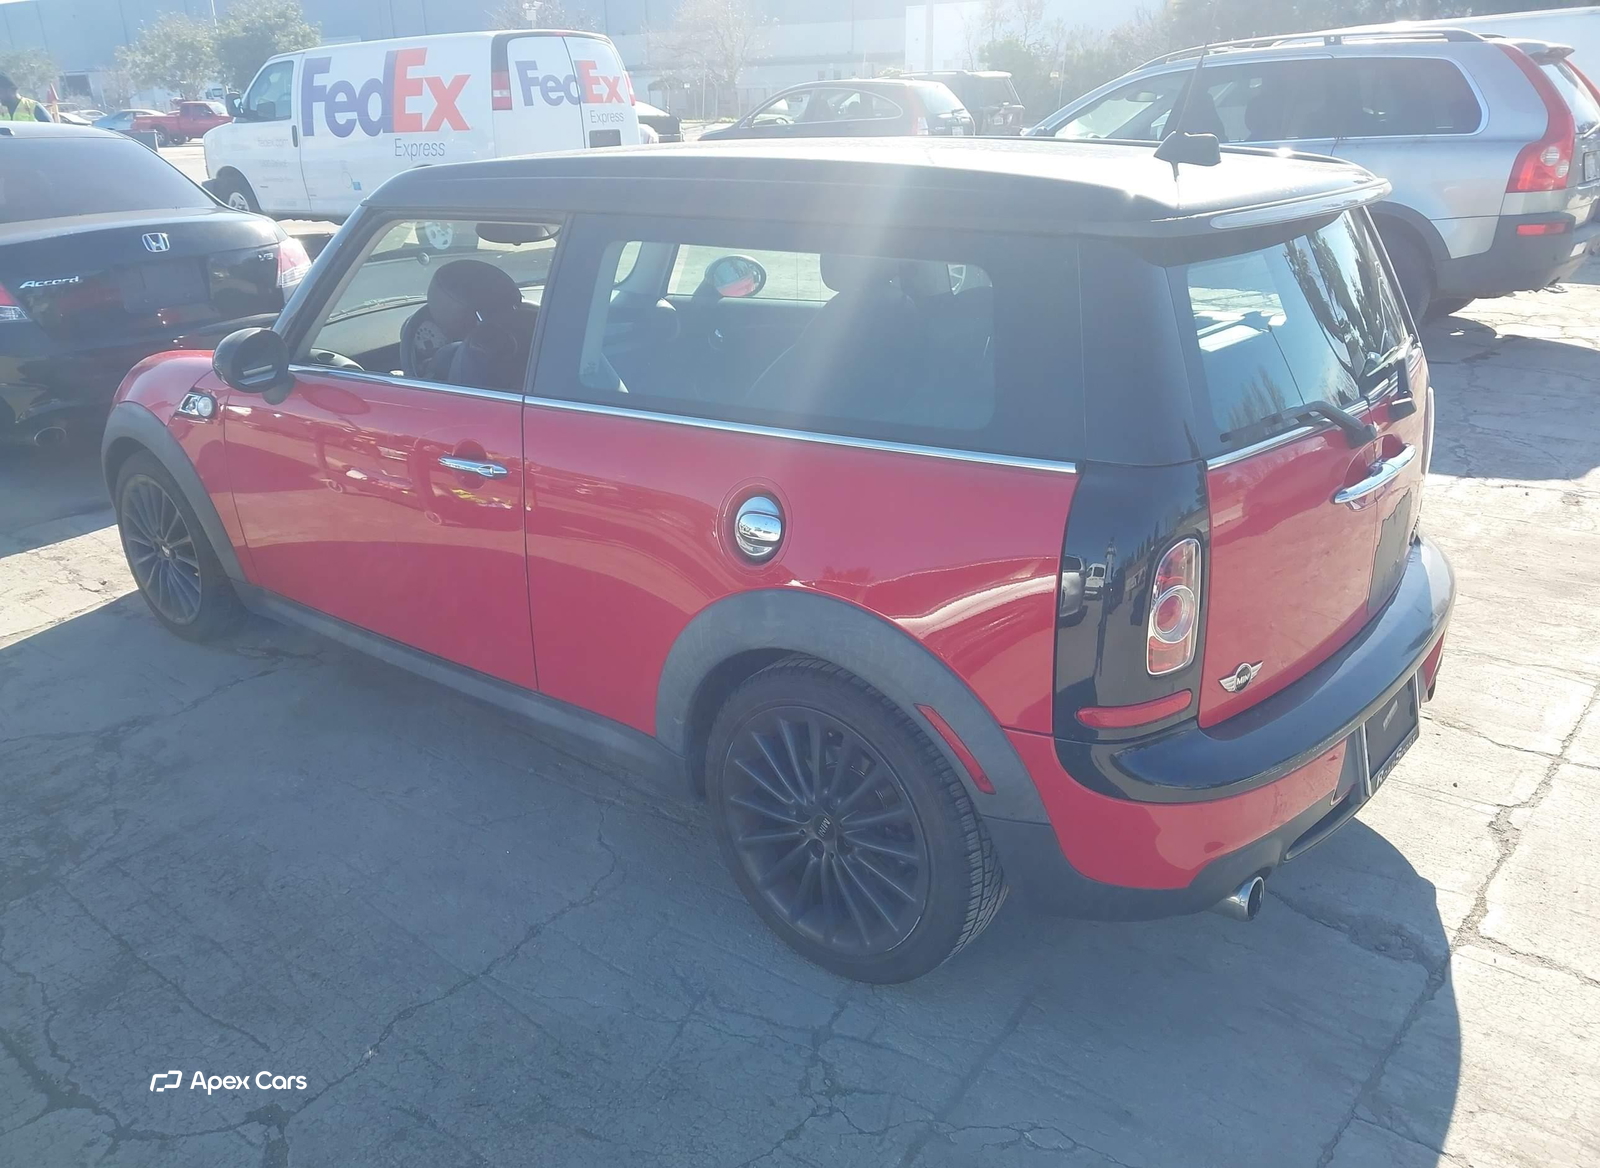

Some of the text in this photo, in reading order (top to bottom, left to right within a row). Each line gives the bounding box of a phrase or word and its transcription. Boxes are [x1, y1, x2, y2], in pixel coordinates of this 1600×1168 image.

[301, 47, 472, 138] FedEx
[515, 60, 625, 107] FedEx
[590, 110, 625, 125] Express
[394, 138, 446, 161] Express
[19, 275, 80, 289] Accord
